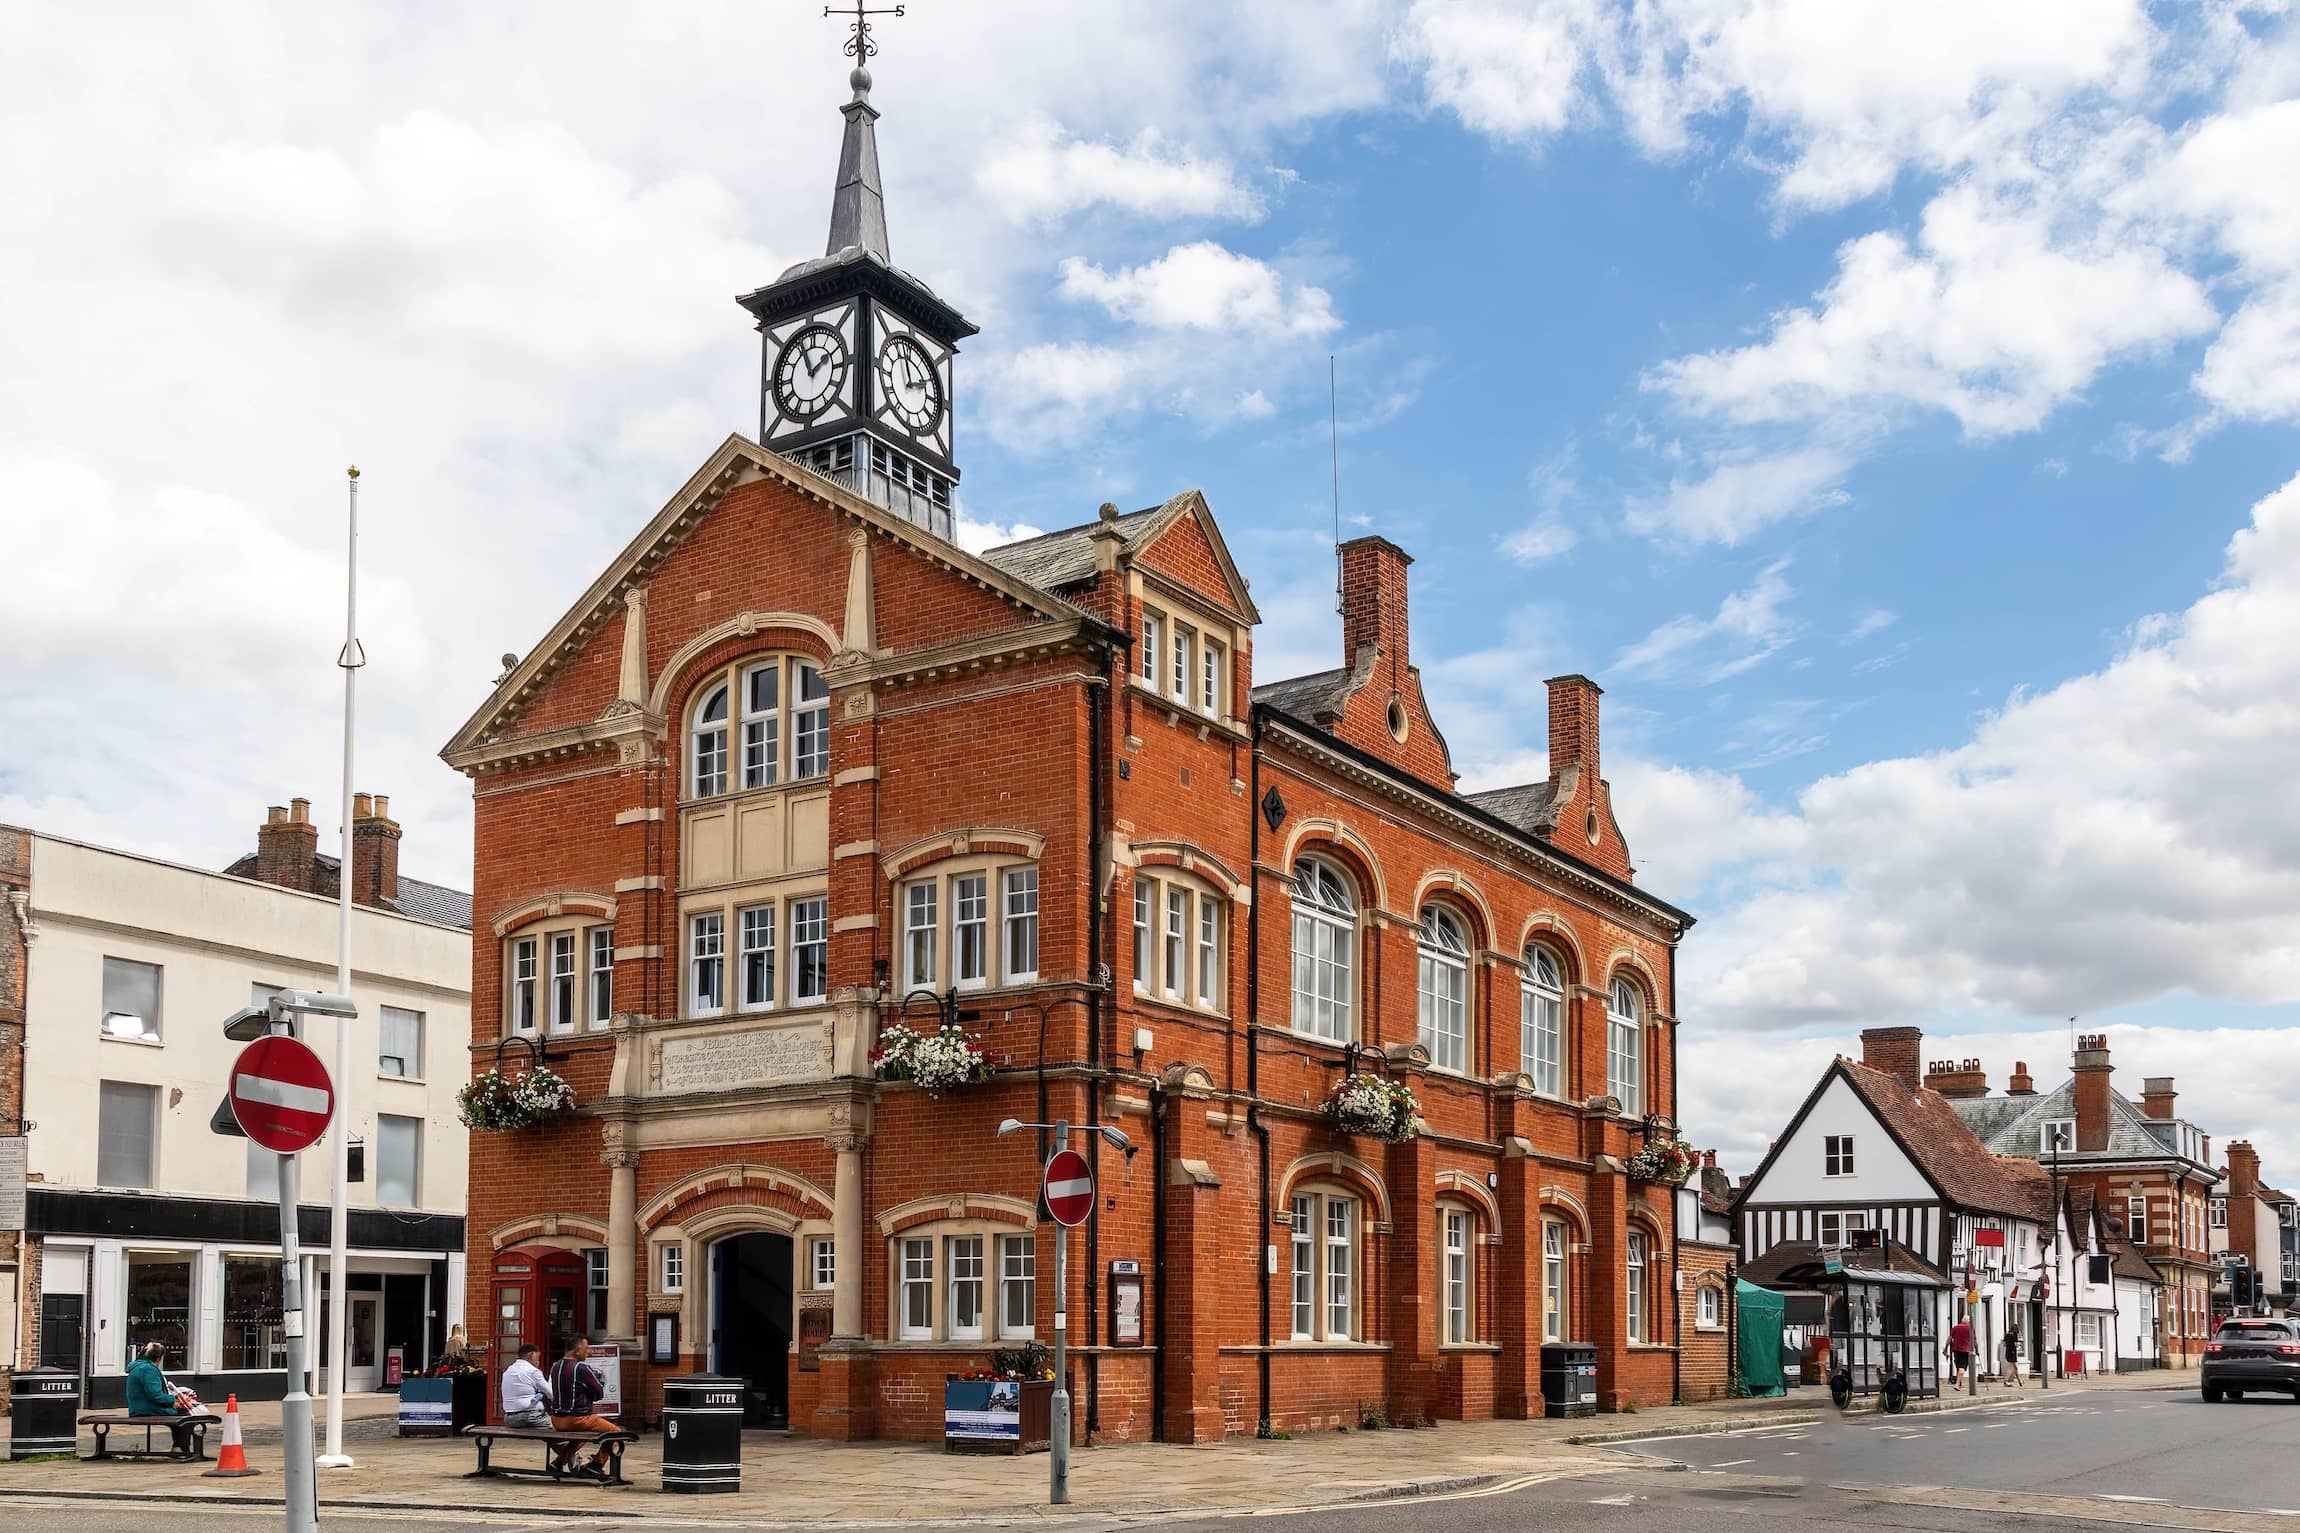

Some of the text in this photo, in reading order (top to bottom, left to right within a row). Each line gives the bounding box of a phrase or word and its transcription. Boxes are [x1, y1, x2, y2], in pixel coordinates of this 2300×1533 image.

[895, 4, 905, 18] S
[41, 1382, 72, 1391] LITTER
[705, 1393, 737, 1404] LITTER
